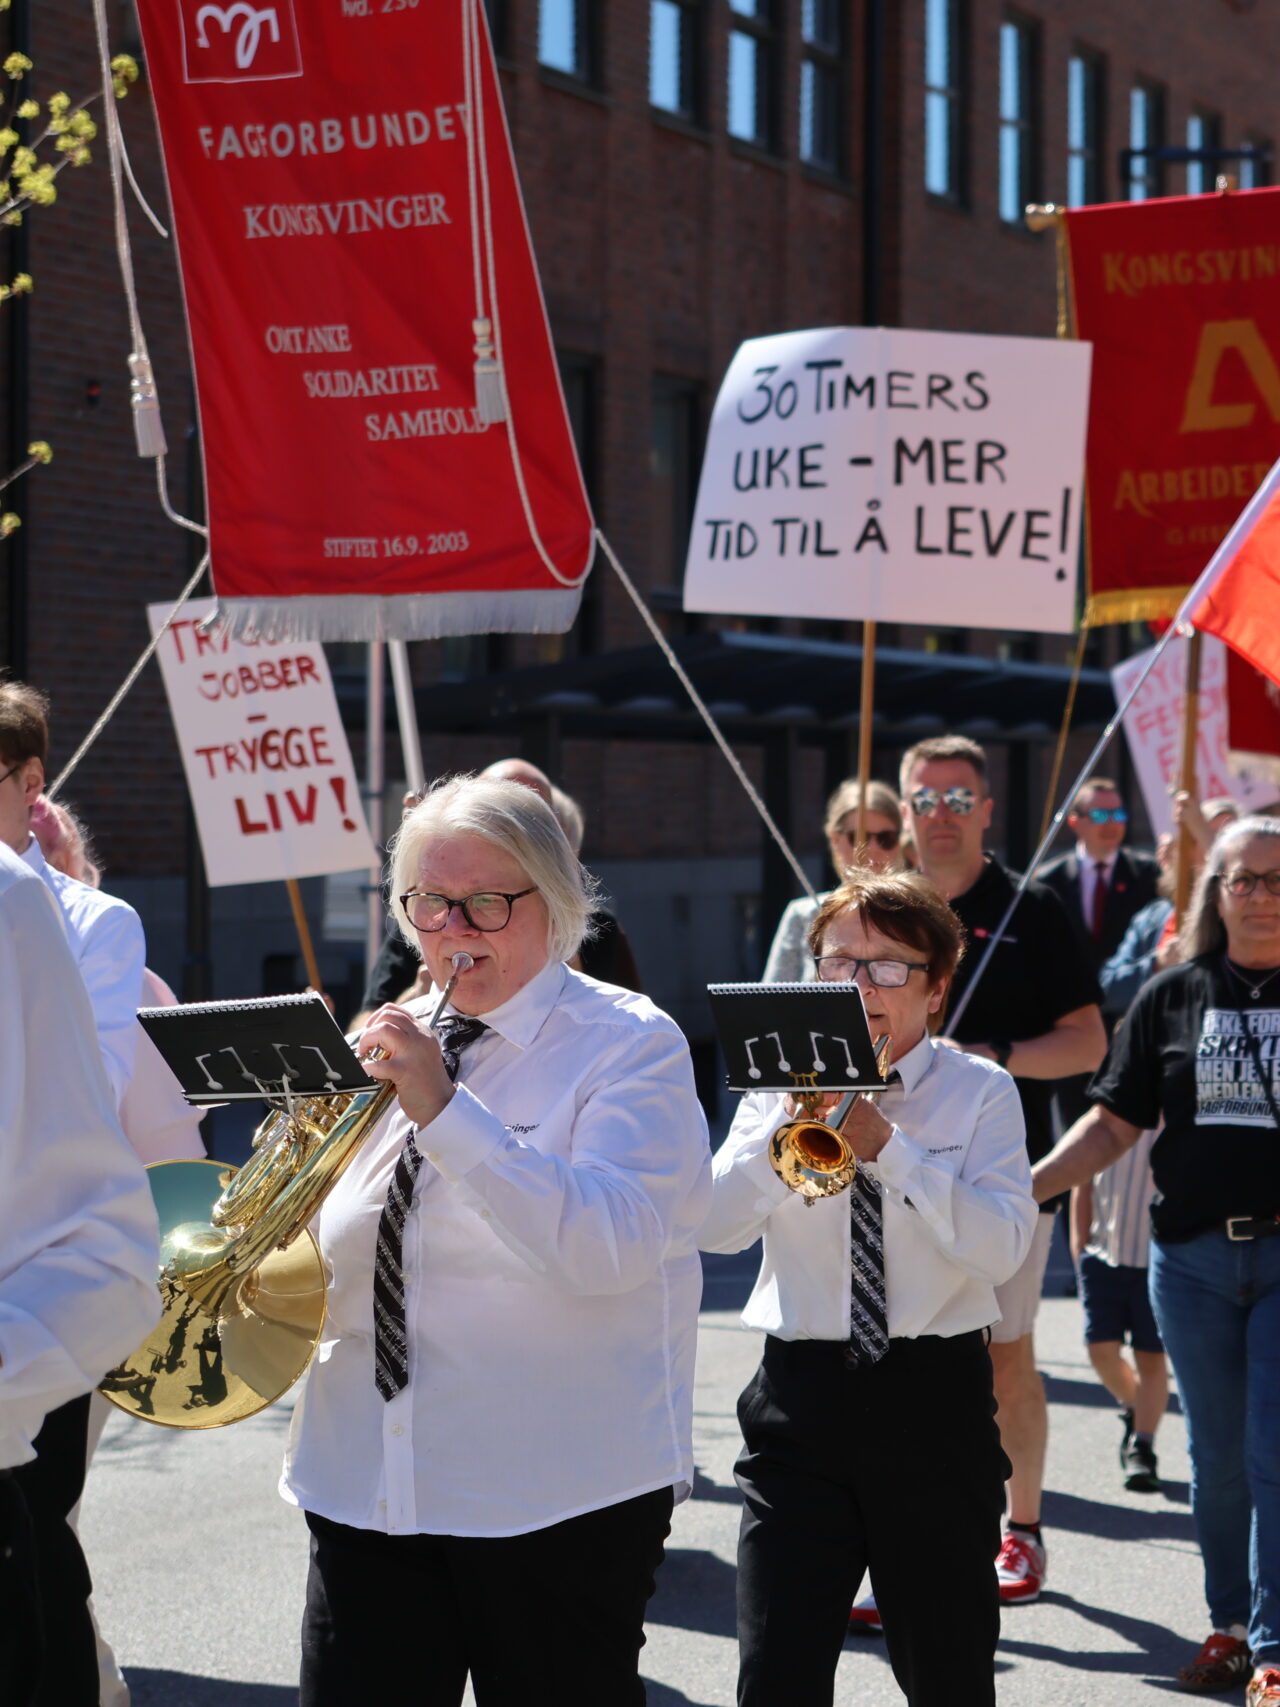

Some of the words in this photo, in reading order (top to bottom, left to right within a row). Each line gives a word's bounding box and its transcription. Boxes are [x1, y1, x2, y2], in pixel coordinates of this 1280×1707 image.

[199, 103, 470, 160] FAGFORBUNDET
[243, 193, 452, 239] KONGSVINGER
[303, 364, 440, 398] SOLIDARITET
[737, 366, 798, 424] 30
[804, 360, 990, 414] TIMERS
[733, 443, 827, 492] UKE
[893, 437, 1008, 486] MER
[324, 537, 378, 558] STIFTET
[427, 530, 469, 555] 2003
[705, 519, 758, 561] TID
[772, 518, 840, 557] TIL
[854, 499, 889, 554] Å
[914, 487, 1072, 582] LEVE!
[198, 655, 321, 701] JOBBER
[194, 725, 335, 779] TRYGGE
[233, 776, 358, 836] LIV!
[1202, 1013, 1243, 1034] IKKE
[1197, 1060, 1236, 1082] MEN
